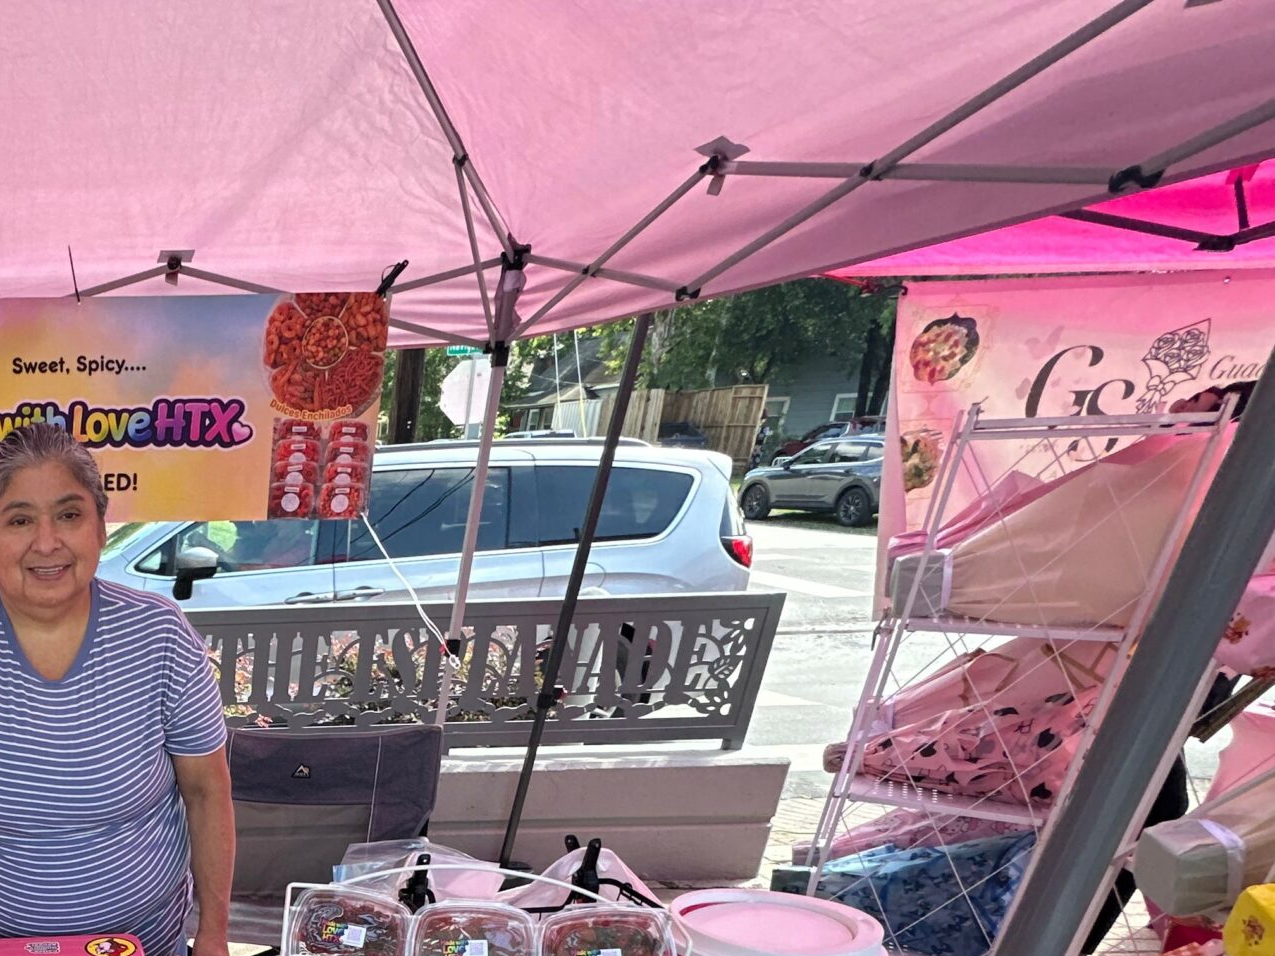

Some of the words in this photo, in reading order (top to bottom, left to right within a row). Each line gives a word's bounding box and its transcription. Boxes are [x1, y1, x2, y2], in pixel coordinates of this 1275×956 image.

[12, 357, 70, 375] Sweet,
[270, 399, 301, 418] Dulces
[302, 404, 353, 420] Enchilados
[155, 402, 241, 443] HTX
